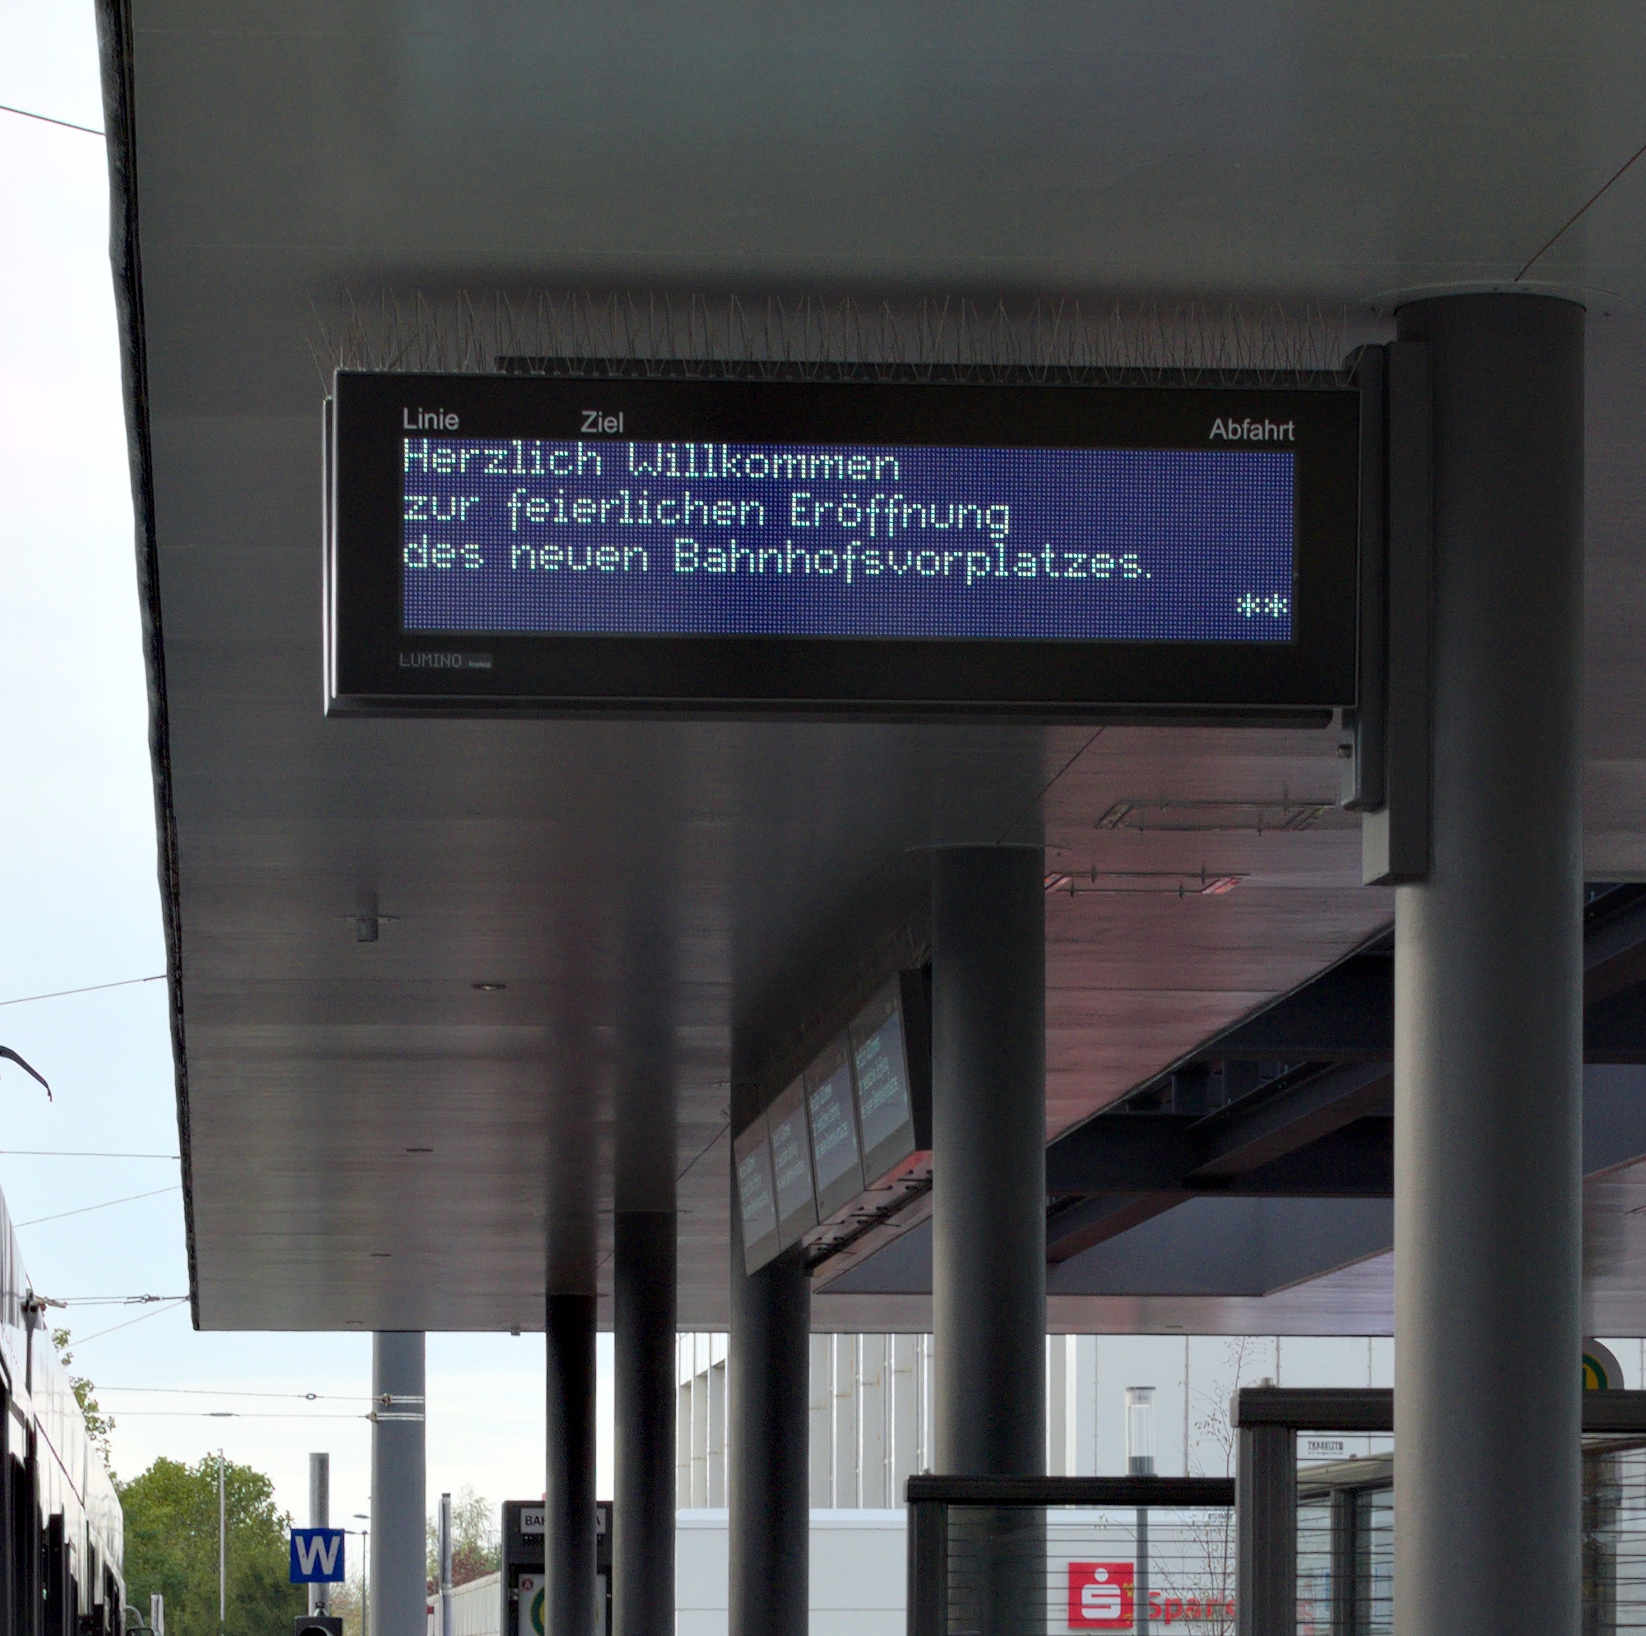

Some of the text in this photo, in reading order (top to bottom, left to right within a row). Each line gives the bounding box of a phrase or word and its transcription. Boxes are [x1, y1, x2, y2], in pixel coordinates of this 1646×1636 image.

[403, 407, 1296, 441] Linie Ziel Abfahrt
[404, 437, 899, 480] Herzlich Willkommen
[404, 487, 1009, 539] zur feierlichen Eröffnung
[404, 533, 1152, 586] des neuen Bahnhofsvorplatzes.
[294, 1535, 341, 1576] W
